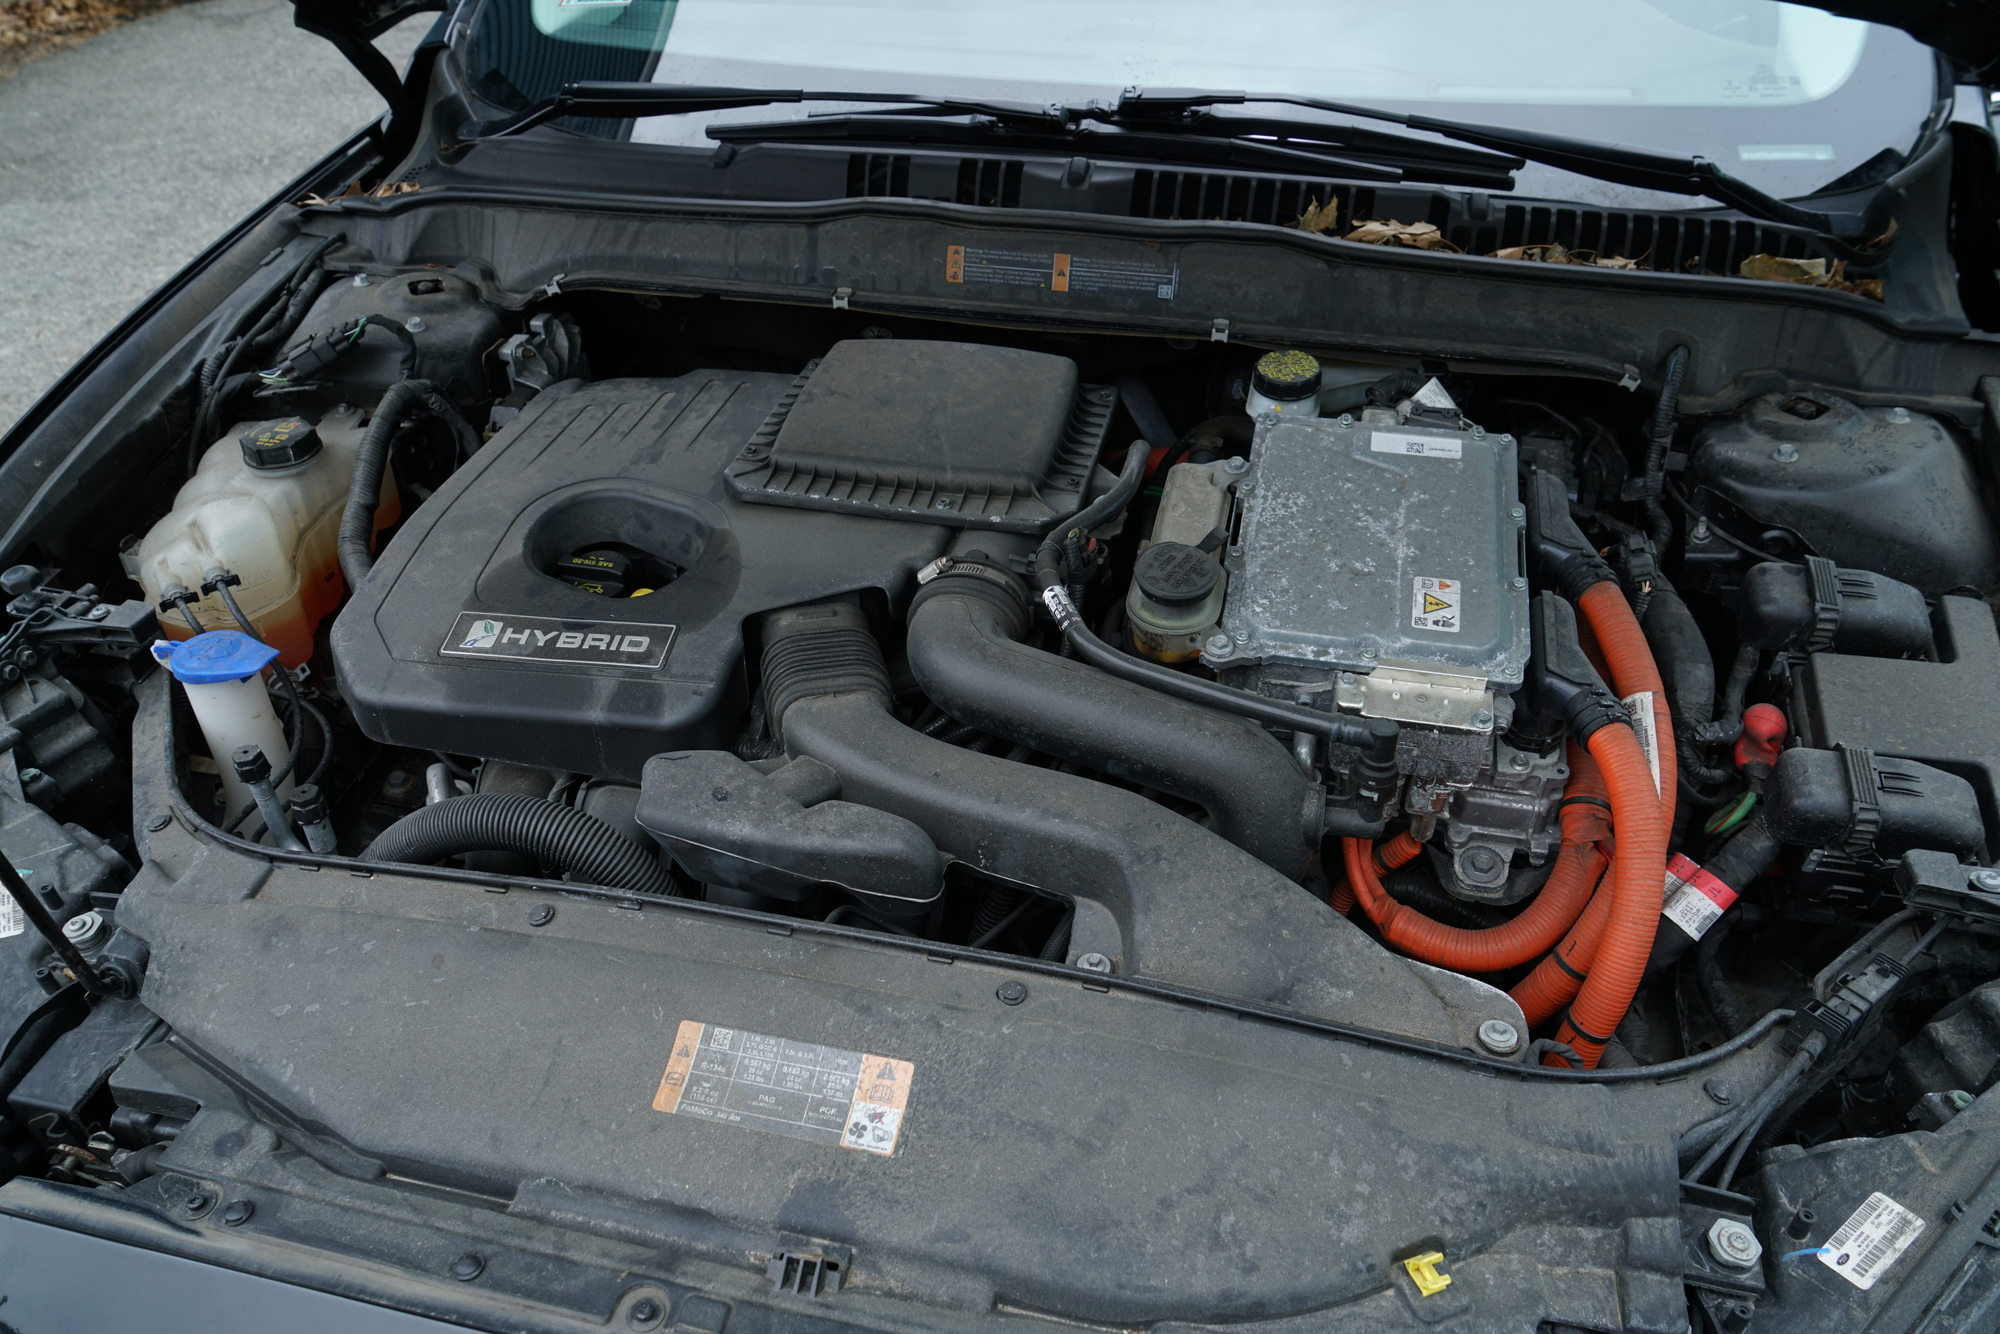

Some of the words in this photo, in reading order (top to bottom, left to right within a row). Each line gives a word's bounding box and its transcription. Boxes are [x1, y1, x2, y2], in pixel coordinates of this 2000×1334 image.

[501, 628, 651, 653] HYBRID
[701, 1061, 726, 1073] R-134a
[762, 1061, 771, 1071] kg
[758, 1094, 776, 1104] PAG
[681, 1103, 713, 1116] FoMoCo
